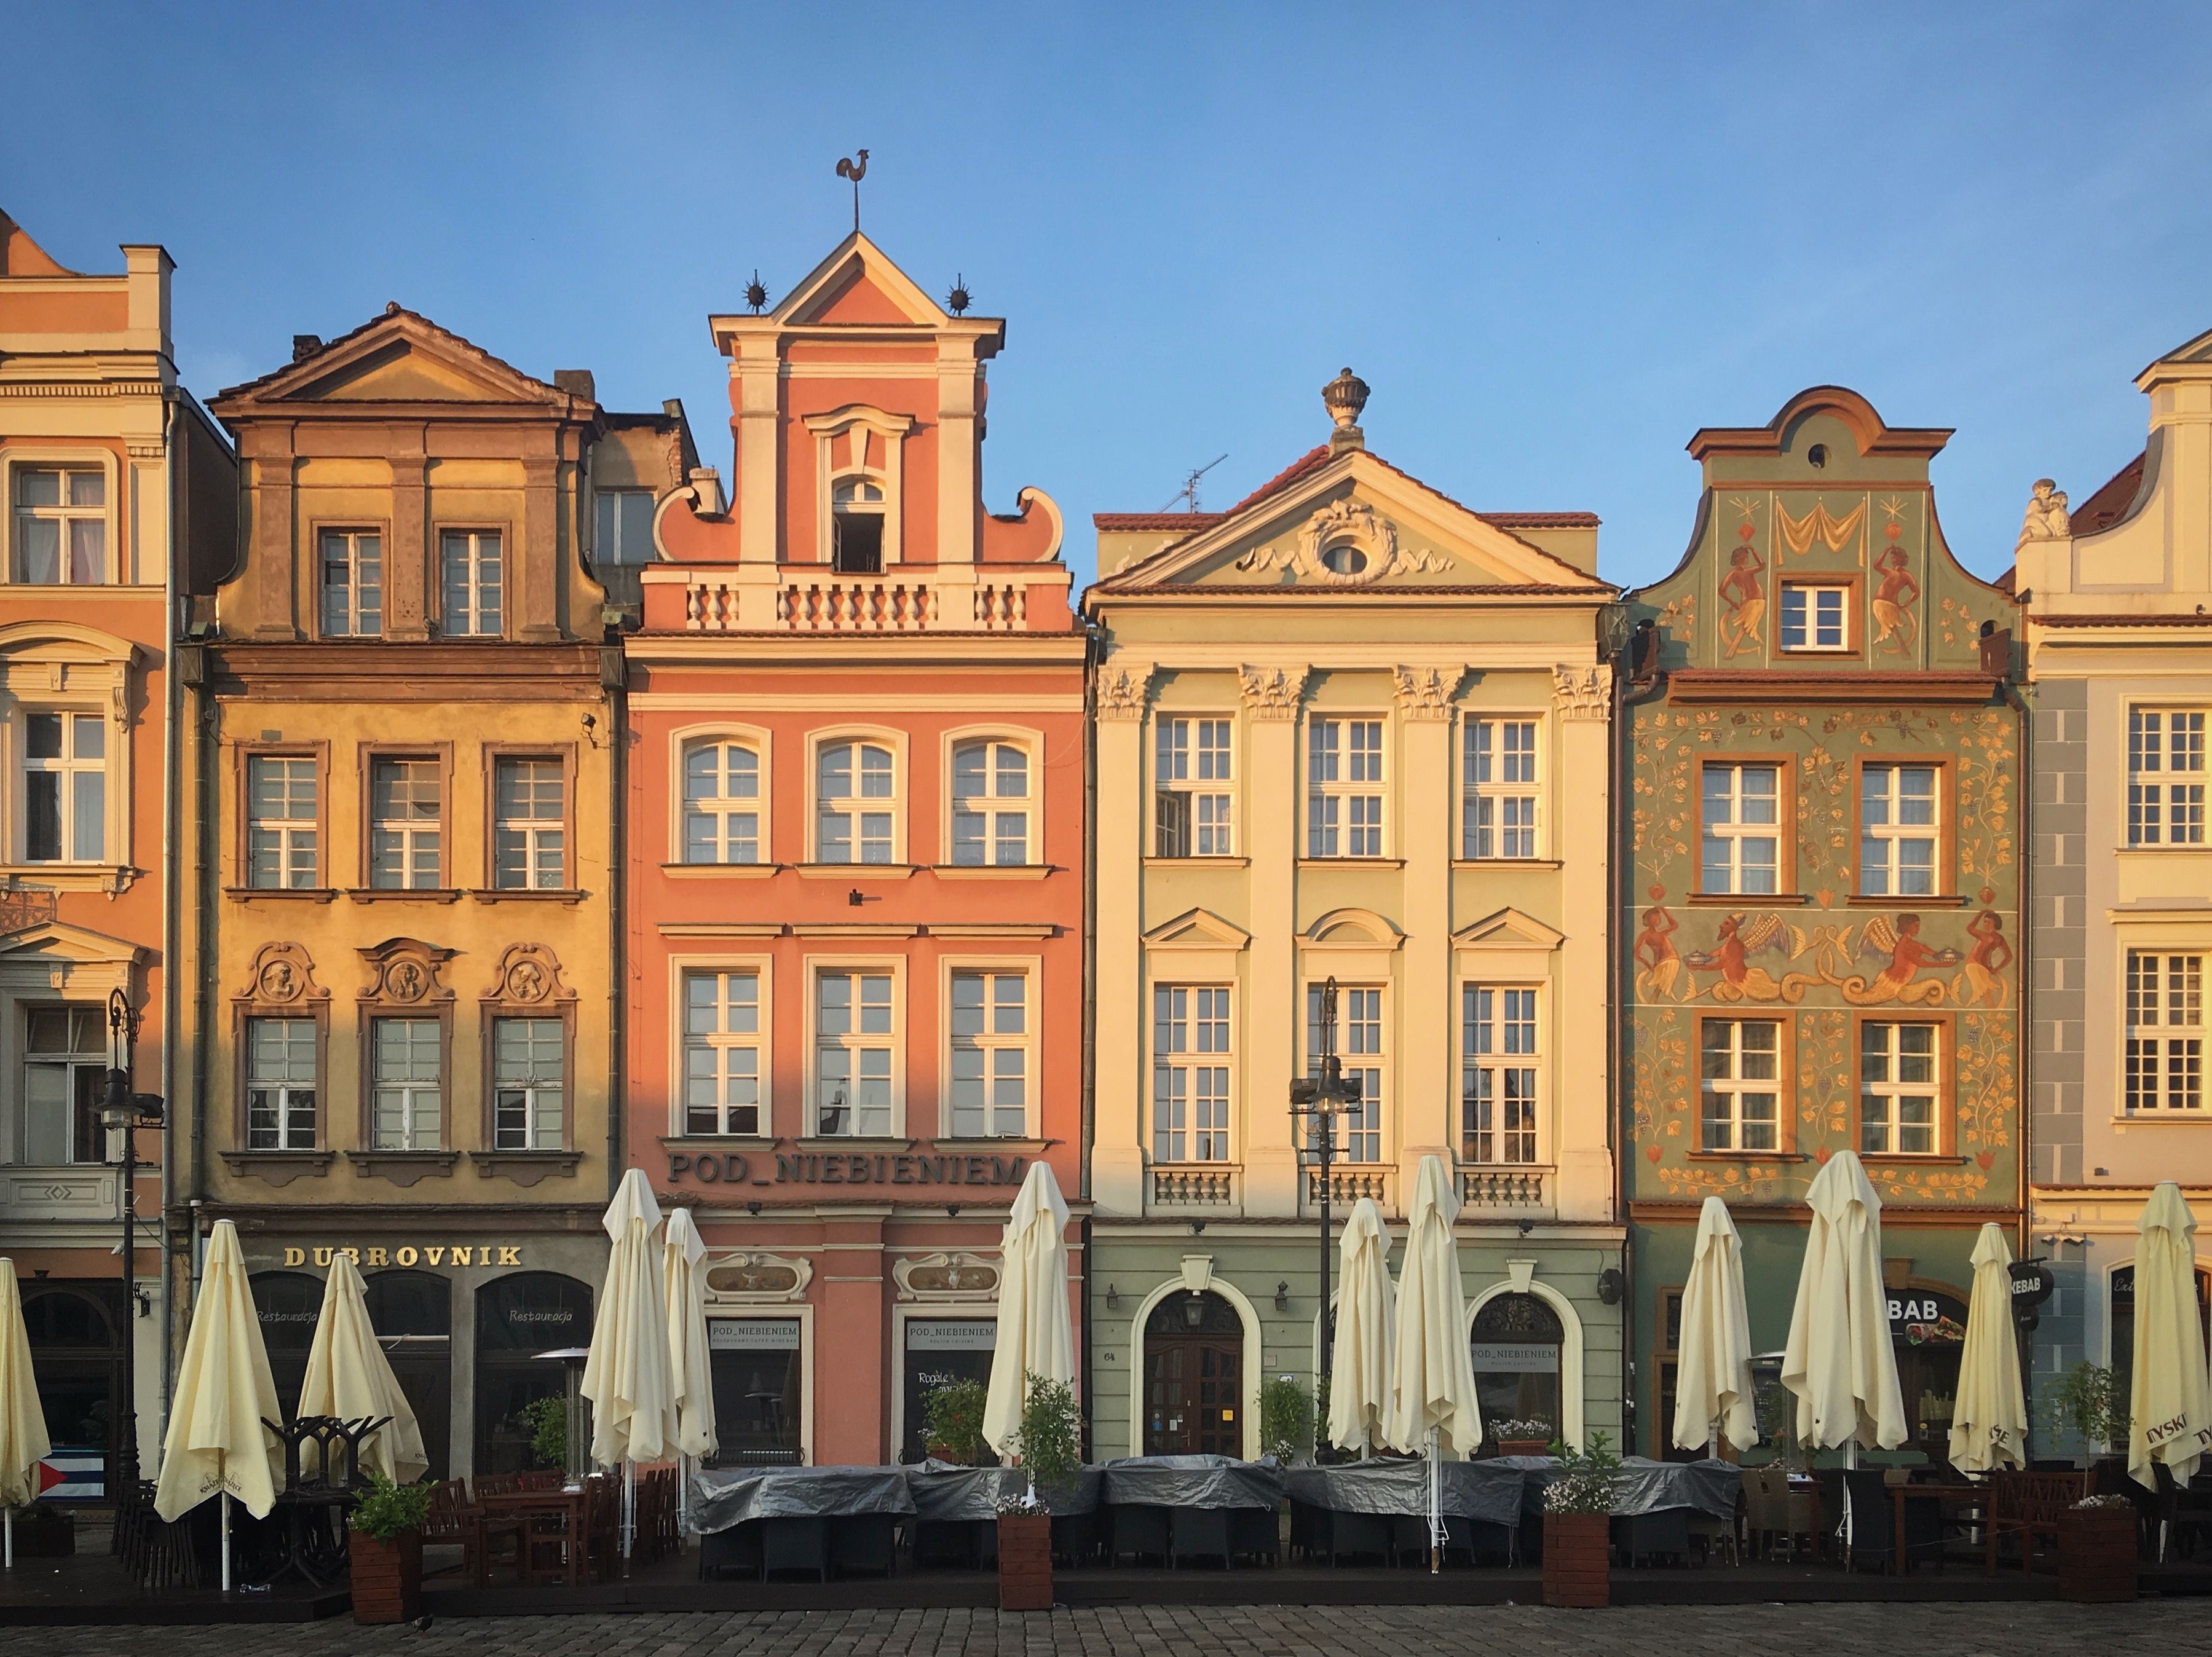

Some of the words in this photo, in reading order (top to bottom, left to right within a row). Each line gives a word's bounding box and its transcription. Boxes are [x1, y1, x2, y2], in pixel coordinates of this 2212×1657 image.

[667, 1153, 1024, 1184] POD_NIEBIENIEM
[284, 1246, 522, 1267] DUBROVNIK
[256, 1310, 318, 1324] Restauracja
[509, 1310, 573, 1324] Restauracja
[1888, 1300, 1938, 1320] BAB
[910, 1328, 994, 1336] POD_NIEBIENIEM
[1104, 1352, 1115, 1361] 64
[1472, 1350, 1557, 1359] POD_NIEBIENIEM
[918, 1371, 949, 1386] Rogale
[2146, 1412, 2187, 1444] TYSKI
